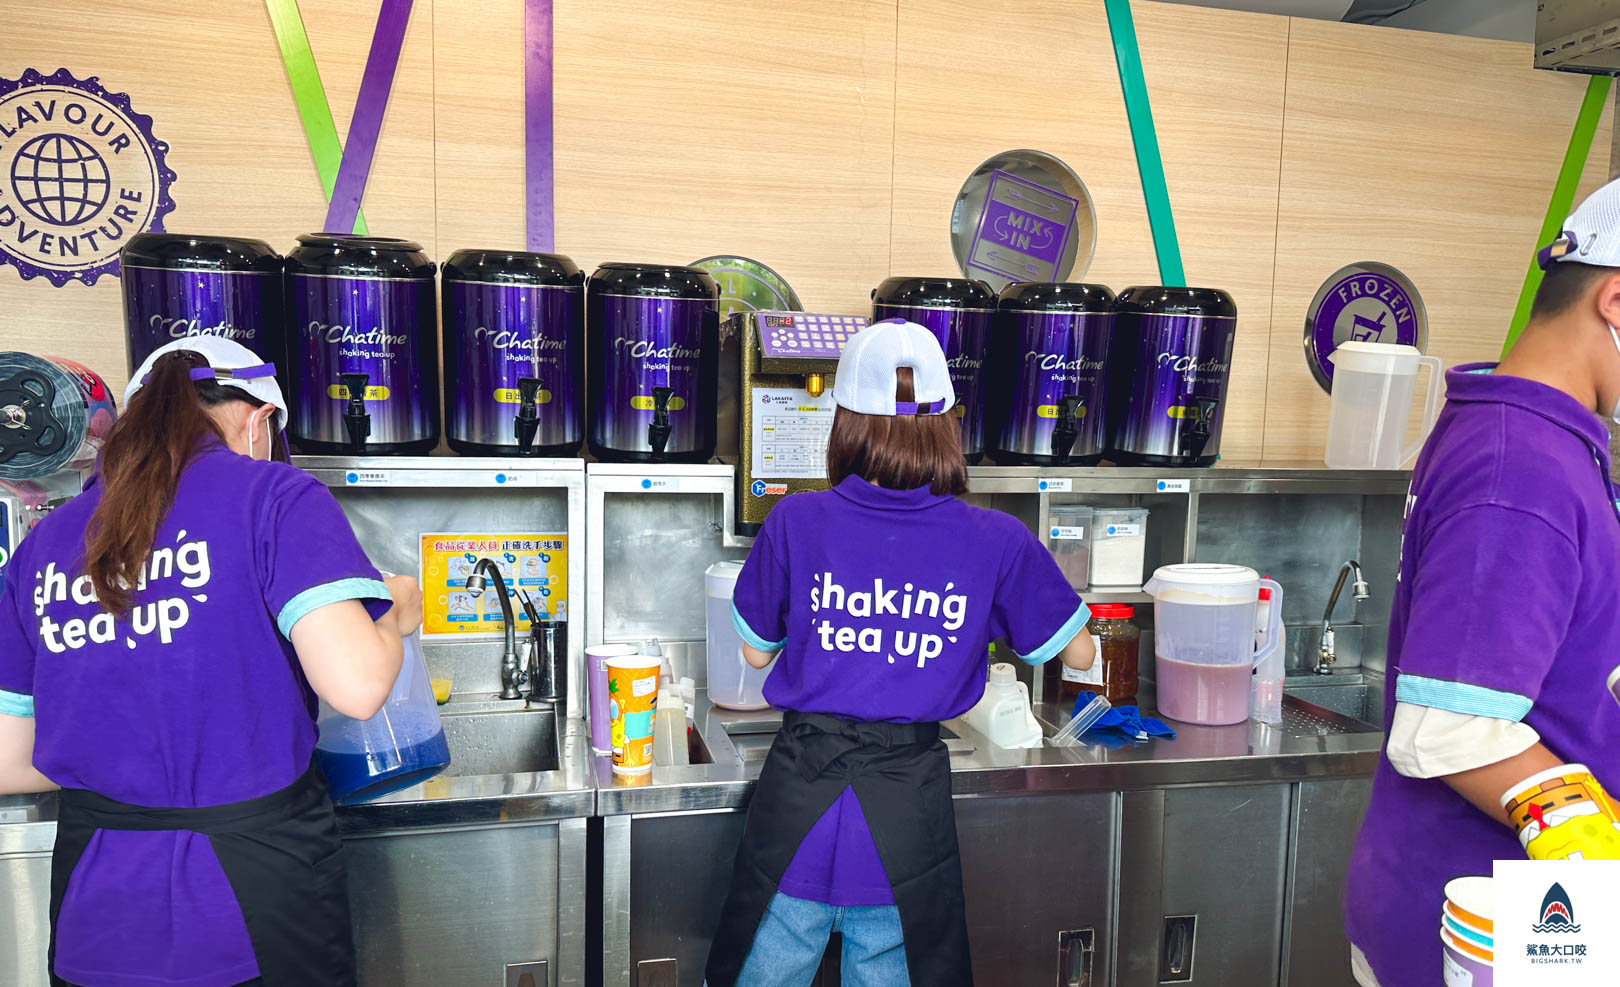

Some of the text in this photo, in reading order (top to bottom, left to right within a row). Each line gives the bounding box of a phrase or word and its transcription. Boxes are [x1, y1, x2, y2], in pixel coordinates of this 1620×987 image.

[0, 100, 130, 153] LAVOUR
[0, 187, 142, 256] DVENTURE
[1007, 211, 1044, 236] MIX
[1009, 230, 1032, 250] IN
[1338, 279, 1411, 324] FROZEN
[168, 318, 256, 339] Chatime
[325, 325, 408, 345] Chatime
[493, 331, 567, 350] Chatime
[631, 341, 701, 359] Chatime
[339, 348, 370, 359] shaking
[506, 353, 535, 364] shaking
[947, 353, 983, 369] atime
[1040, 354, 1105, 370] Chatime
[643, 361, 670, 373] shaking
[1173, 355, 1229, 372] Chatime
[1051, 373, 1077, 383] shaking
[755, 484, 788, 494] Freser
[434, 540, 564, 551] 食品從業人員 正確洗手步驟
[34, 539, 211, 616] shaing
[810, 571, 968, 631] shaking
[40, 597, 190, 653] tea up
[817, 620, 943, 668] tea up
